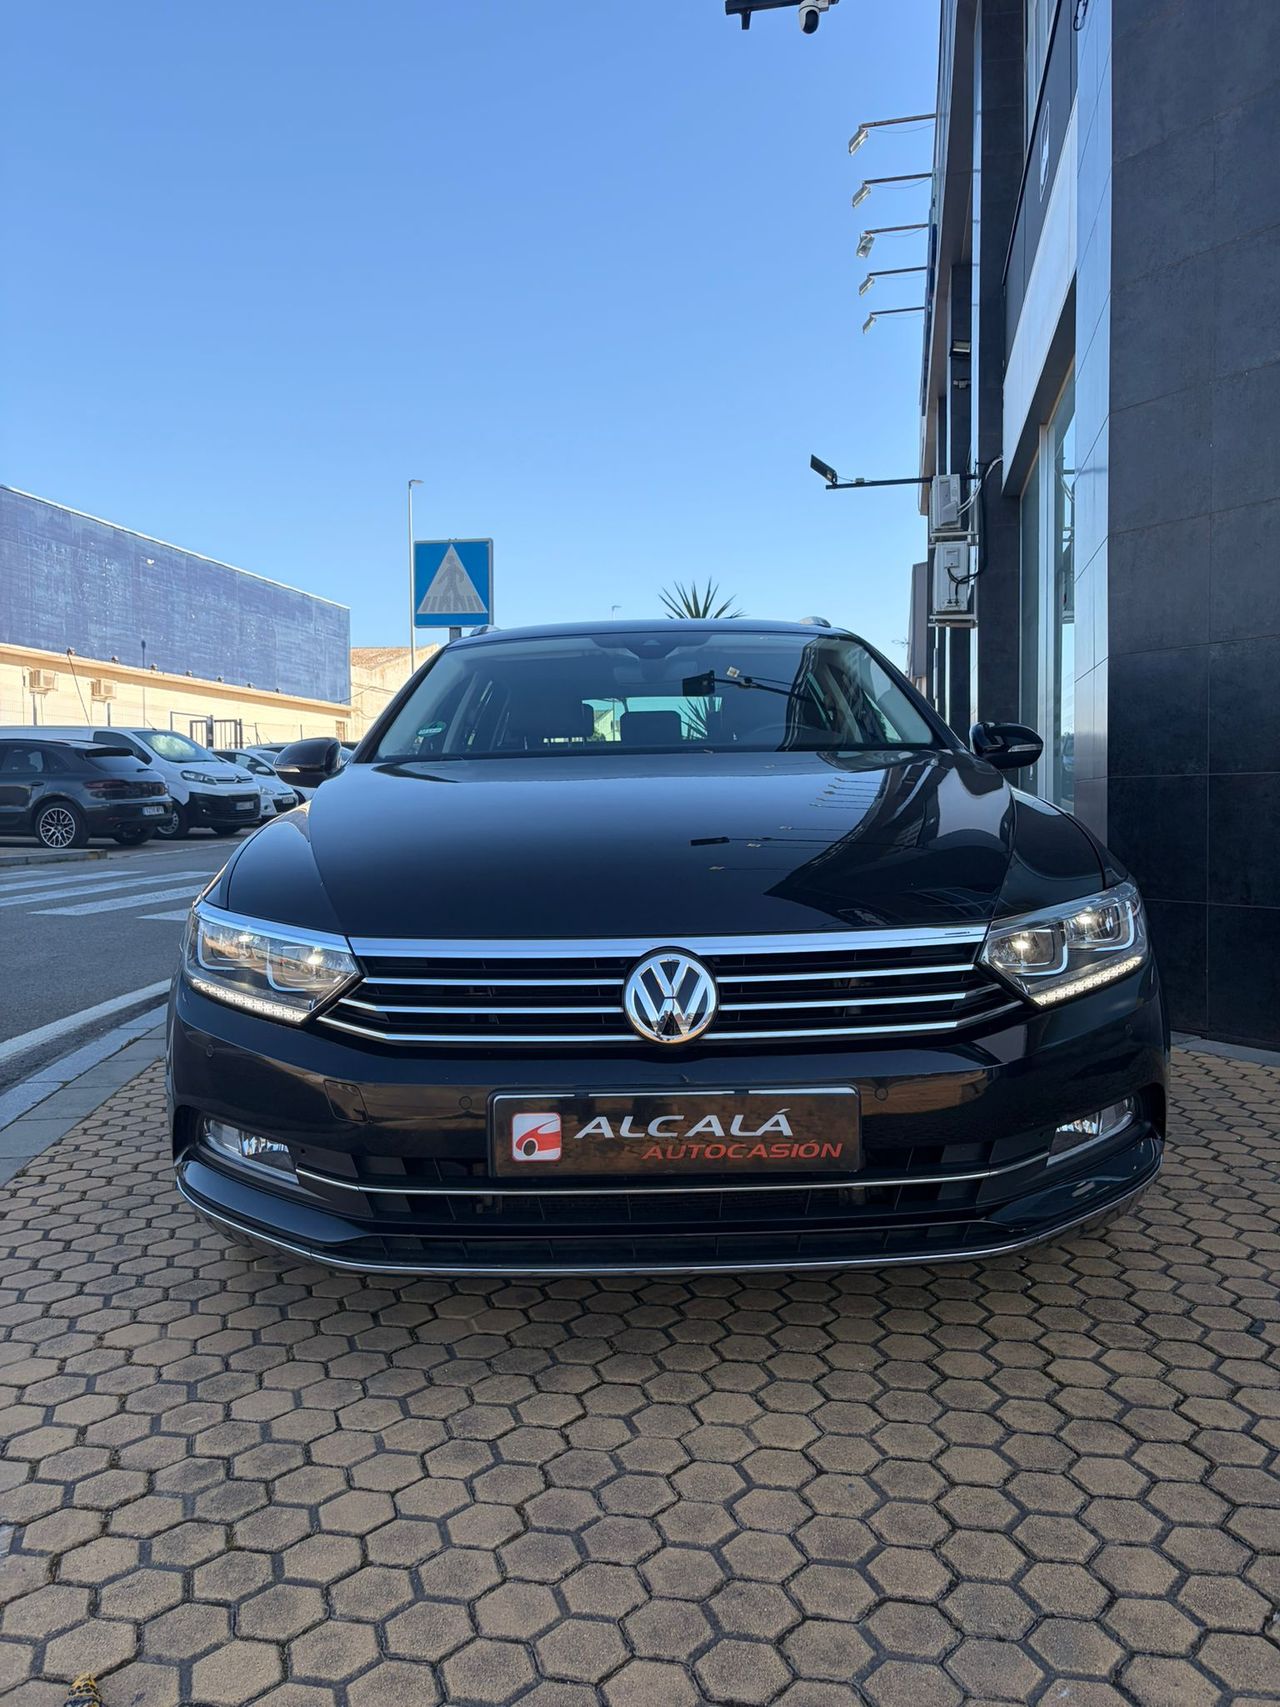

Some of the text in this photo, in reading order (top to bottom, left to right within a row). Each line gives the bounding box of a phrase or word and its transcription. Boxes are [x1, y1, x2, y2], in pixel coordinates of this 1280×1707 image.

[627, 954, 716, 1043] VW
[574, 1108, 794, 1138] ALCALÁ
[642, 1140, 842, 1159] AUTOCASIÓN
